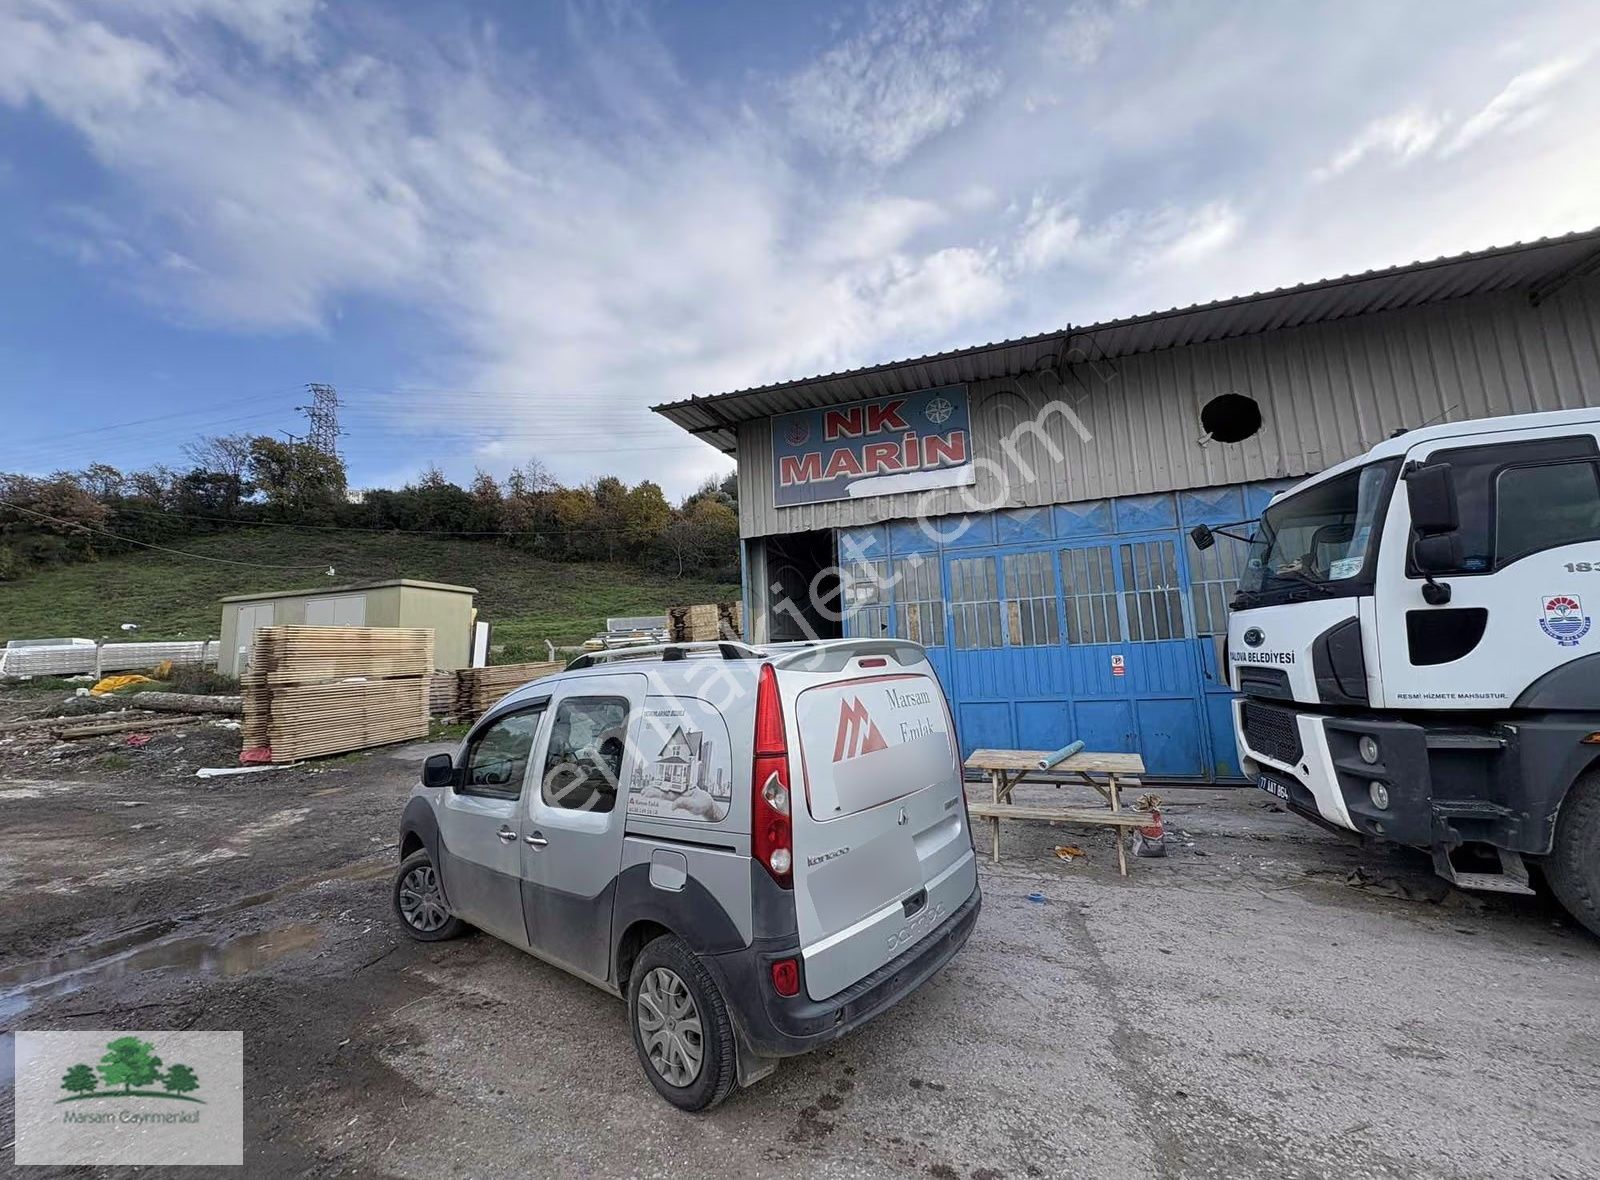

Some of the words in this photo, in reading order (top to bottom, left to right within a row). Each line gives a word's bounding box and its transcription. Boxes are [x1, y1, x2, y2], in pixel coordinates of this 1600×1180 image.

[824, 400, 909, 441] NK
[779, 431, 967, 486] MARİN
[1248, 650, 1296, 664] BELEDİYESİ
[885, 688, 931, 710] Marsam
[900, 717, 934, 742] Emlak
